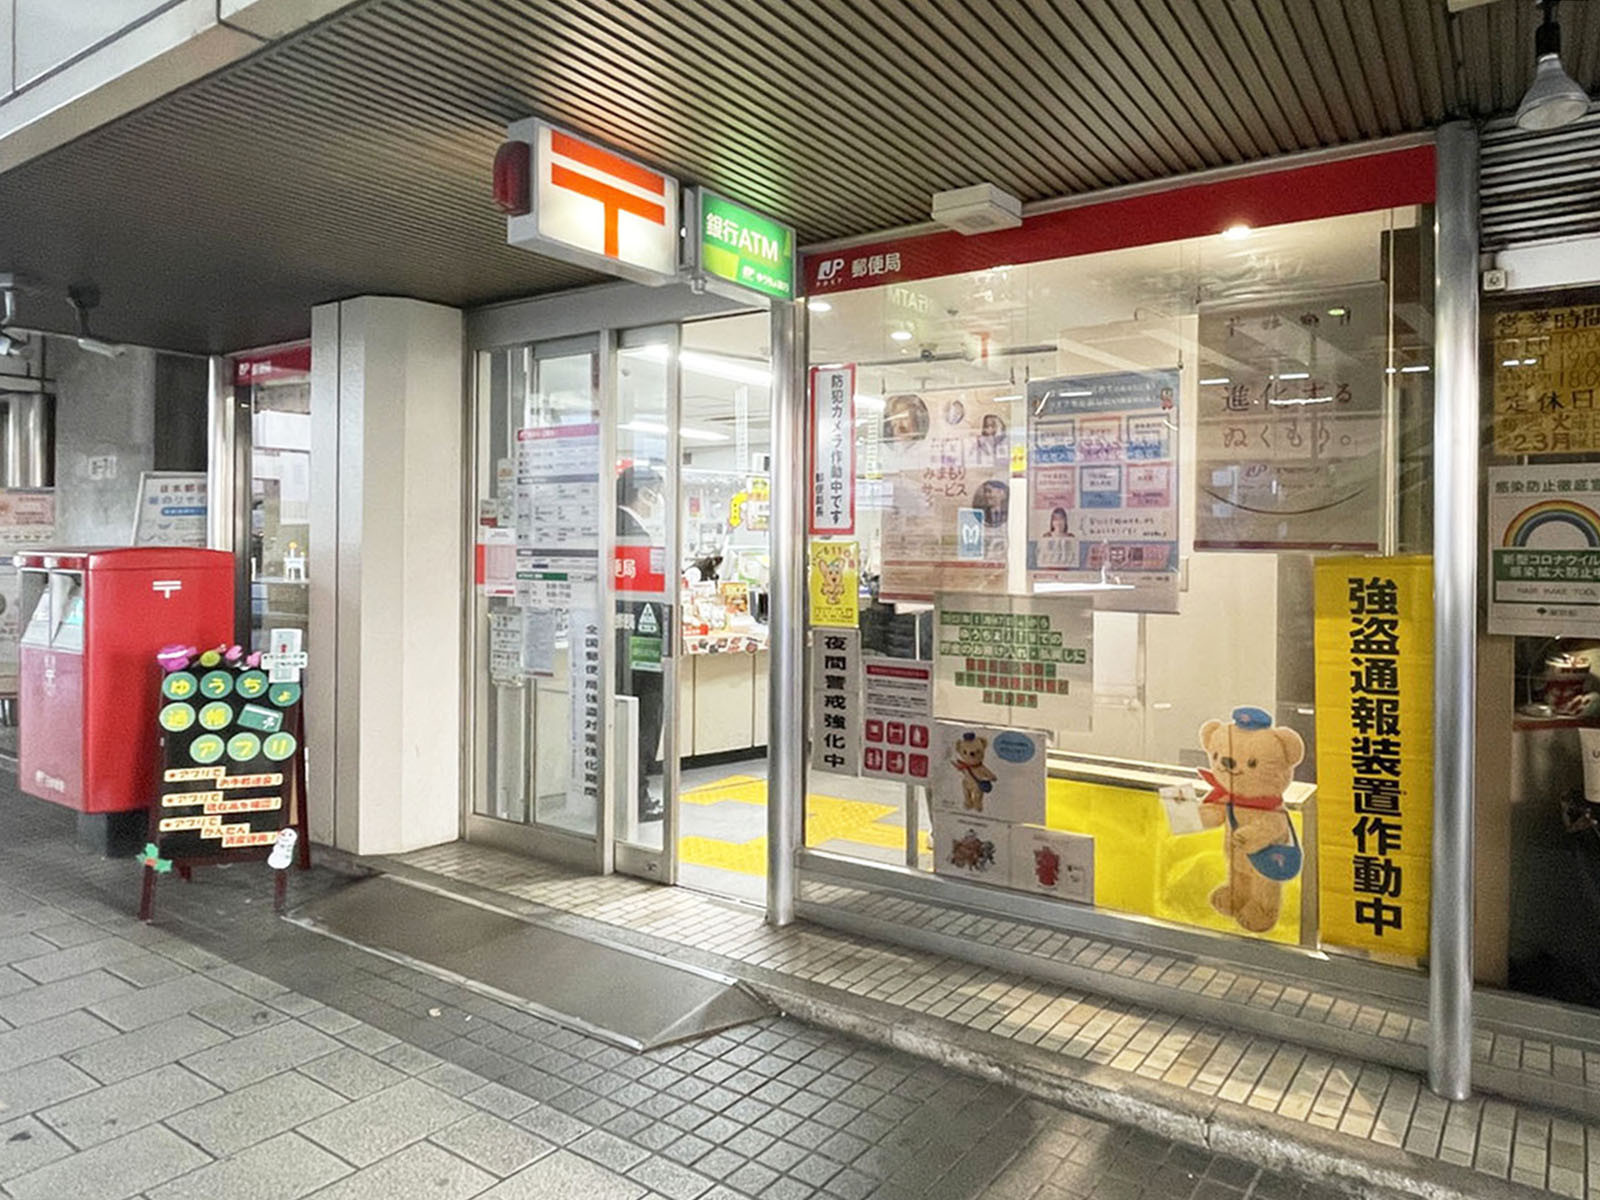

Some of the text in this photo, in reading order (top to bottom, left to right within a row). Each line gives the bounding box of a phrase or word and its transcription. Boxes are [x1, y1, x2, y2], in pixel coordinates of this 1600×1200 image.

[705, 212, 779, 262] 銀行ATM
[851, 253, 901, 278] 郵便局
[1222, 382, 1353, 412] 進化する
[1504, 389, 1594, 413] 定休日
[830, 374, 843, 524] 防犯カメラ作動中です
[922, 466, 966, 481] みまもり
[920, 483, 968, 499] サービス
[170, 677, 292, 703] ゆうちょ
[823, 635, 847, 768] 夜間警戒強化中
[1348, 577, 1403, 937] 強盗通報装置作動中
